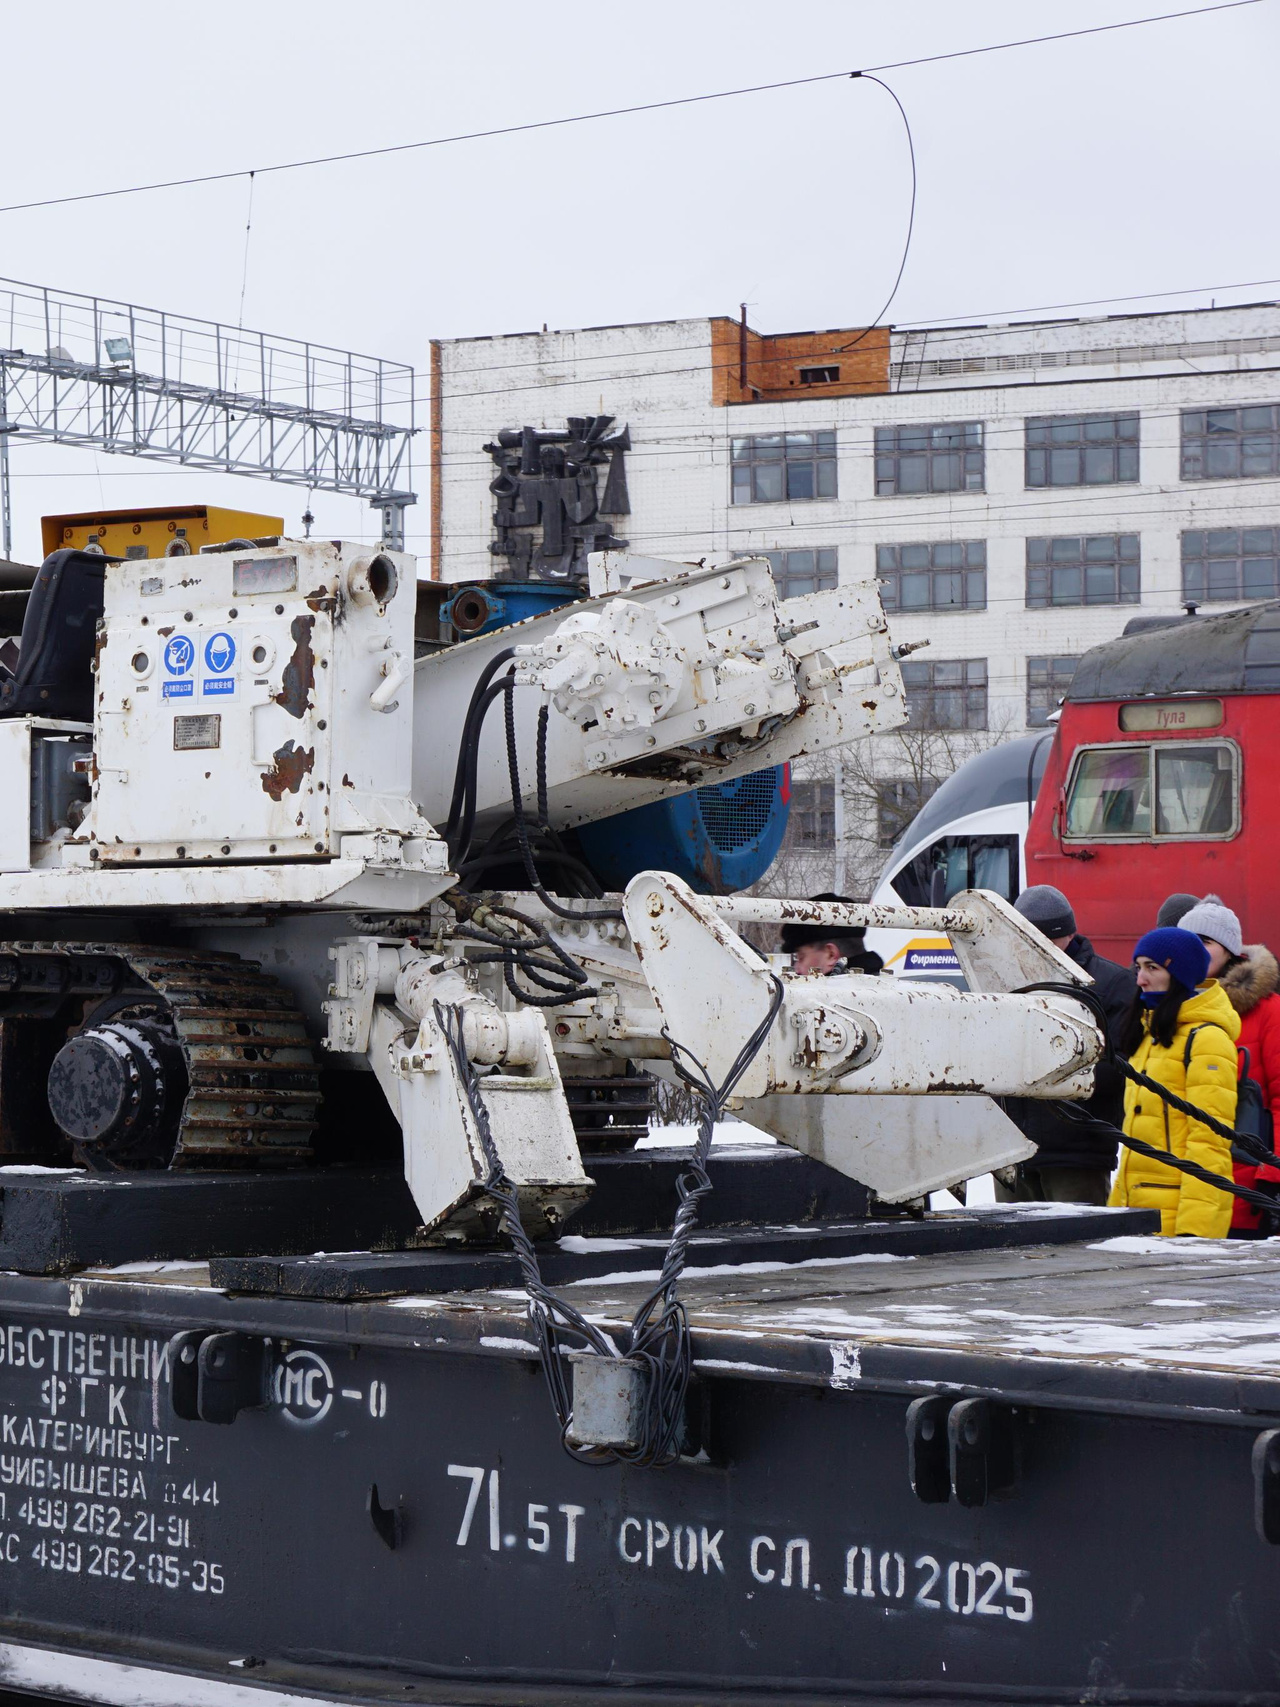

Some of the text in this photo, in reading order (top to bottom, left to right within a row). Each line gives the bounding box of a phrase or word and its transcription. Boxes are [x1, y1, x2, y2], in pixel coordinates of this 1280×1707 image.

[1156, 708, 1186, 728] Тула
[618, 1516, 725, 1575] СРОК
[750, 1535, 821, 1591] СЛ.
[914, 1554, 1034, 1623] 2025
